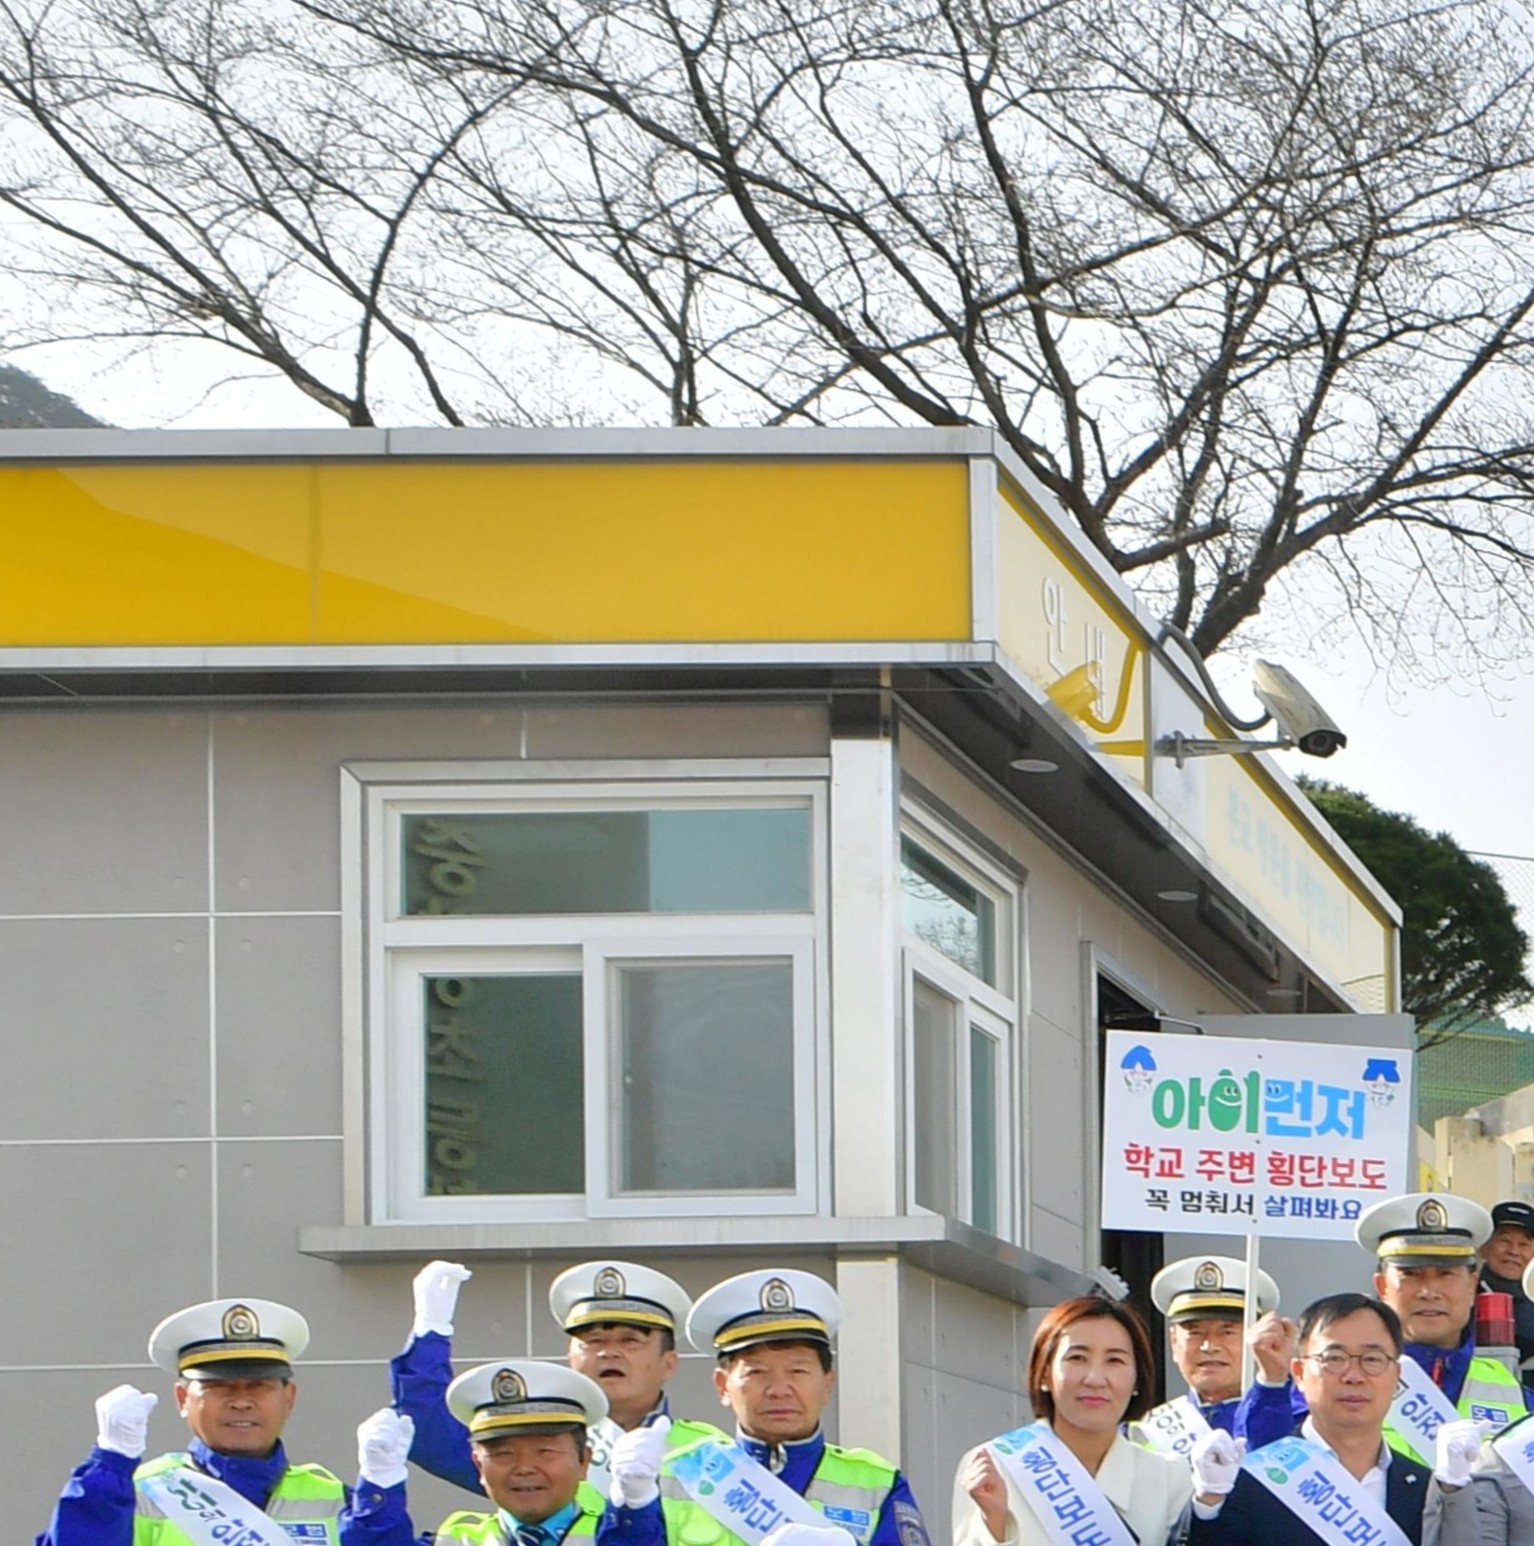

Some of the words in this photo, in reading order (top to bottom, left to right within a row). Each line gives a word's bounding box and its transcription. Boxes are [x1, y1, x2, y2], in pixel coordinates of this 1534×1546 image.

[1152, 1069, 1366, 1139] 아이먼저
[1124, 1143, 1185, 1179] 학교
[1196, 1149, 1255, 1184] 주변
[1267, 1151, 1387, 1190] 횡단보도
[1145, 1188, 1170, 1212] 꼭
[1180, 1190, 1255, 1215] 멈춰서
[1264, 1195, 1362, 1220] 살펴봐요
